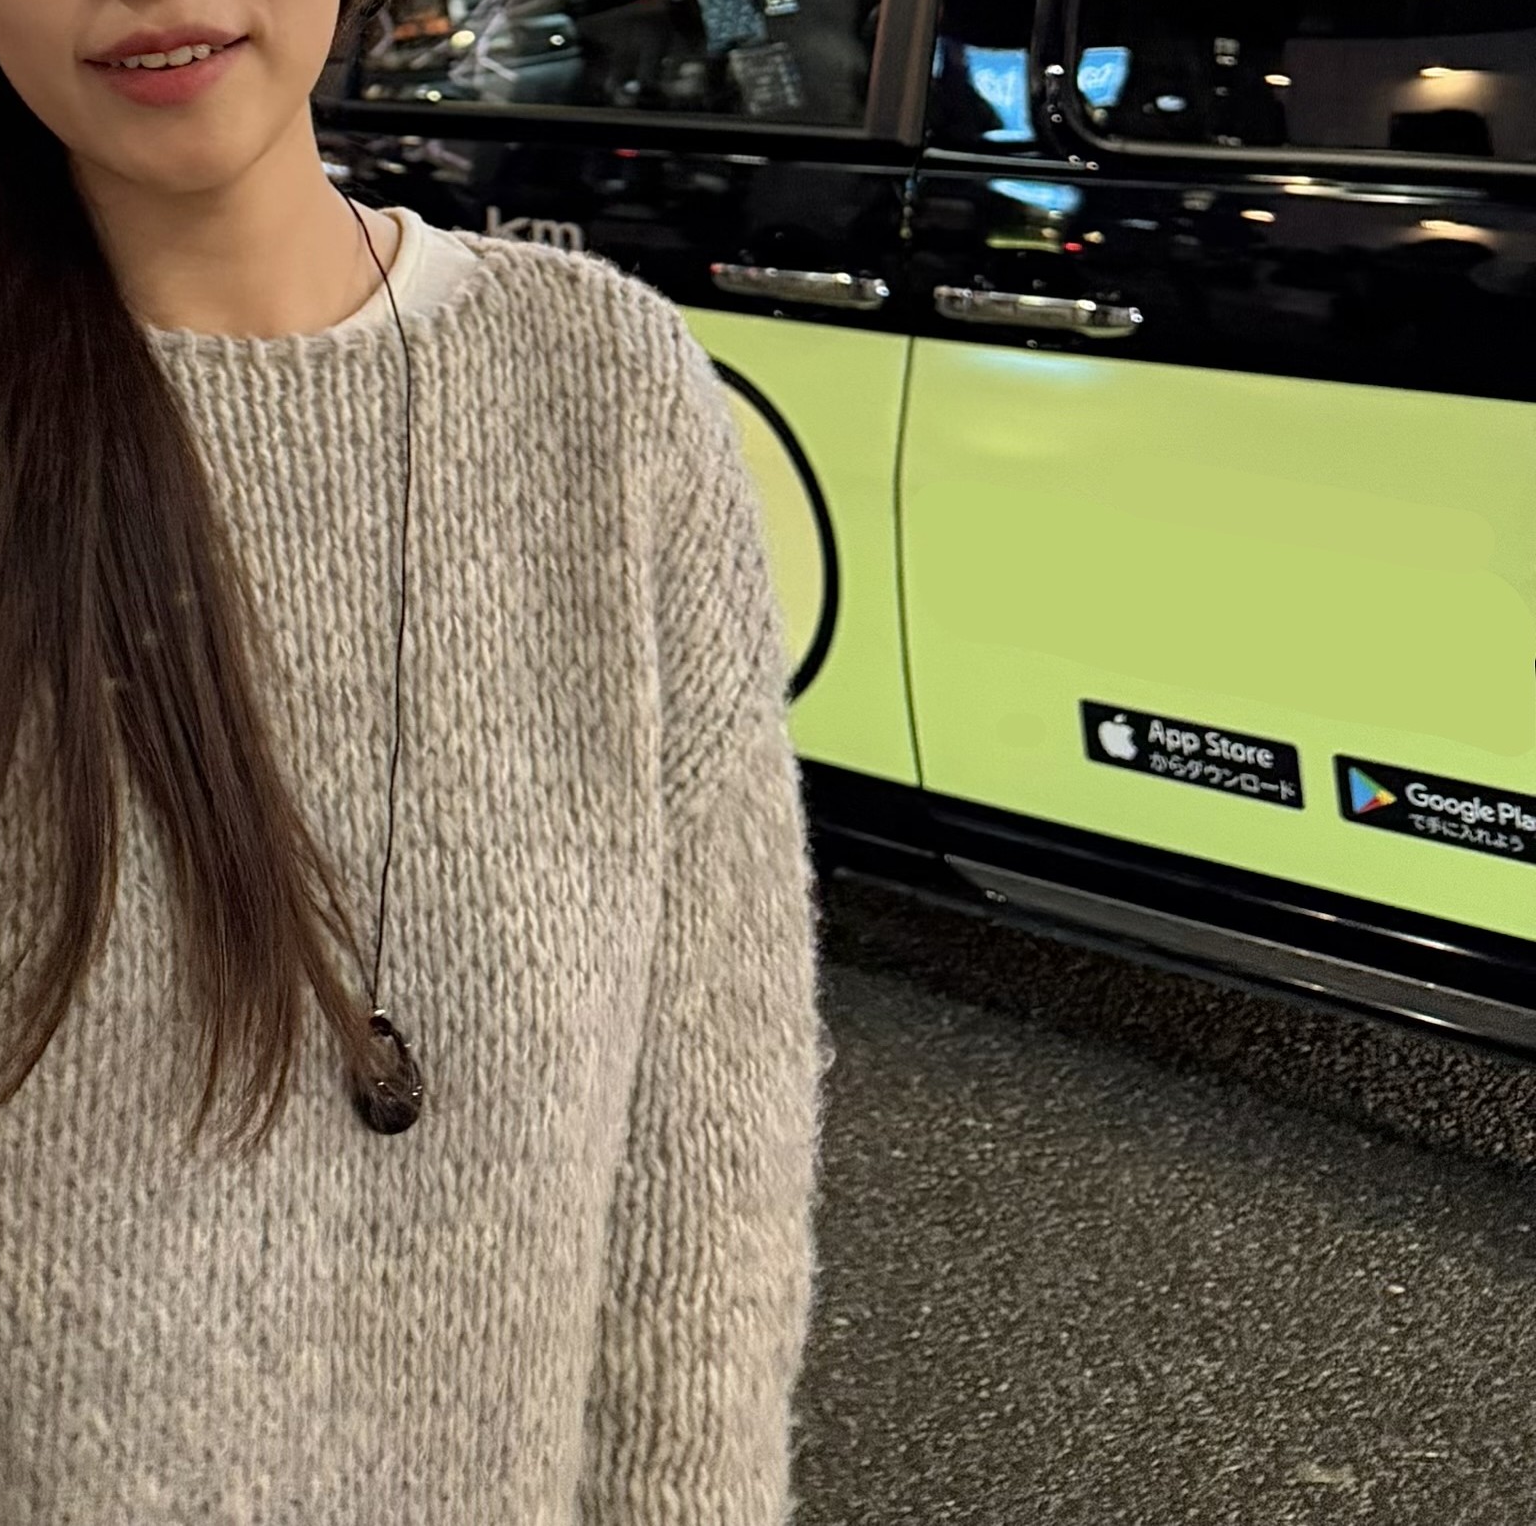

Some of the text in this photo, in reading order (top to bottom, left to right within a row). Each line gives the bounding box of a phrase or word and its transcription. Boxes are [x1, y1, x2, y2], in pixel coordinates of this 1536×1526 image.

[486, 205, 583, 251] km
[1148, 719, 1276, 769] App Store
[1149, 750, 1297, 801] からダウンロード
[1405, 782, 1496, 825] Google
[1408, 813, 1525, 853] て手に入れよう
